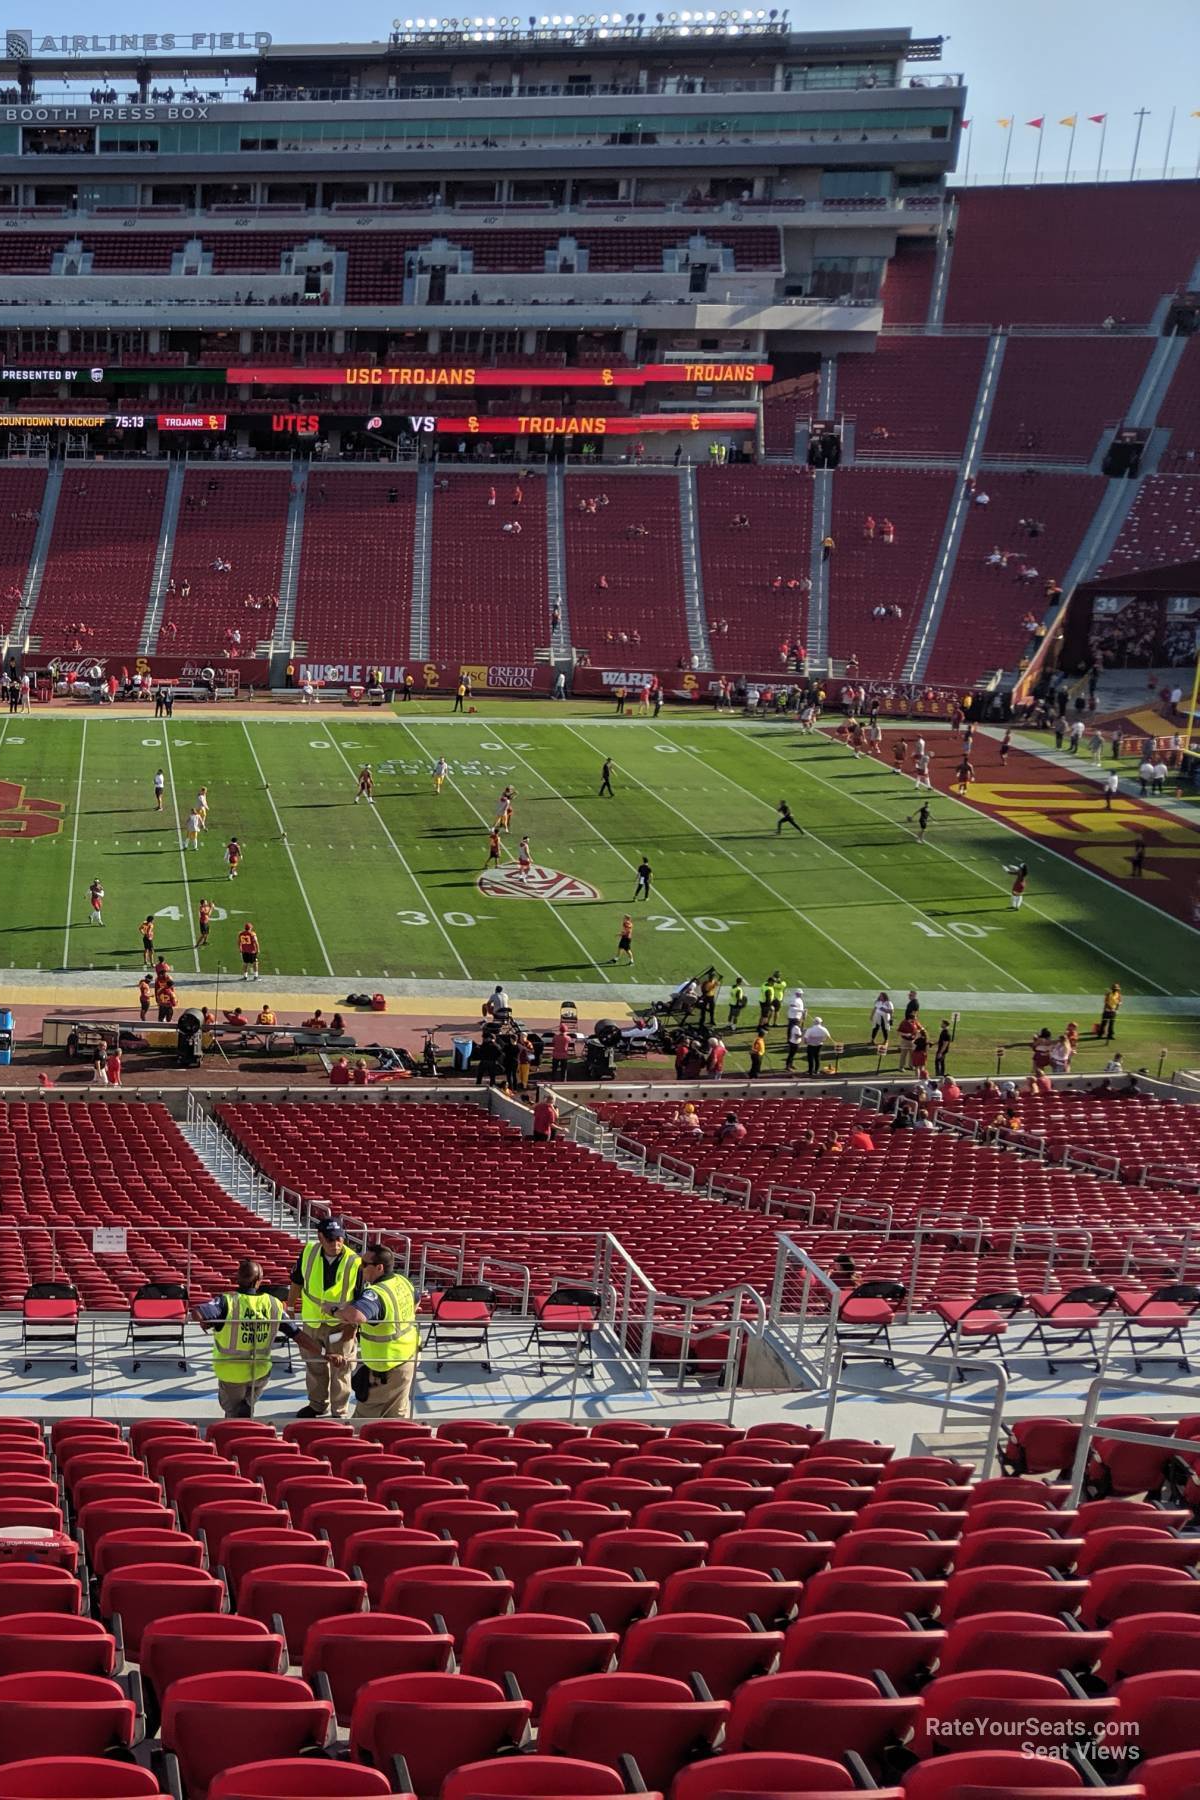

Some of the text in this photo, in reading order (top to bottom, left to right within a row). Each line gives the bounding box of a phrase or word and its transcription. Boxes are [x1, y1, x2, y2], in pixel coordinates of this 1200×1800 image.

[39, 33, 176, 52] AIRLINES
[192, 32, 273, 49] FIELD
[6, 107, 78, 121] BOOTH
[89, 107, 156, 120] PRESS
[167, 107, 209, 119] BOX
[1, 369, 78, 381] PRESENTED BY
[346, 369, 476, 385] USC TROJANS
[685, 365, 755, 382] TROJANS
[55, 416, 66, 427] TO
[67, 416, 105, 428] KICKOFF
[115, 416, 144, 428] 75:13
[165, 418, 204, 428] TROJANS
[273, 415, 319, 432] UTES
[411, 416, 435, 432] VS
[518, 417, 607, 434] TROJANS
[299, 664, 362, 682] MUSCLE
[488, 666, 538, 678] CREDIT
[488, 677, 534, 688] UNION
[396, 910, 477, 927] 30
[646, 914, 734, 933] 20
[912, 920, 990, 939] 10
[240, 1321, 270, 1332] SECRITY
[241, 1333, 268, 1344] GRUP
